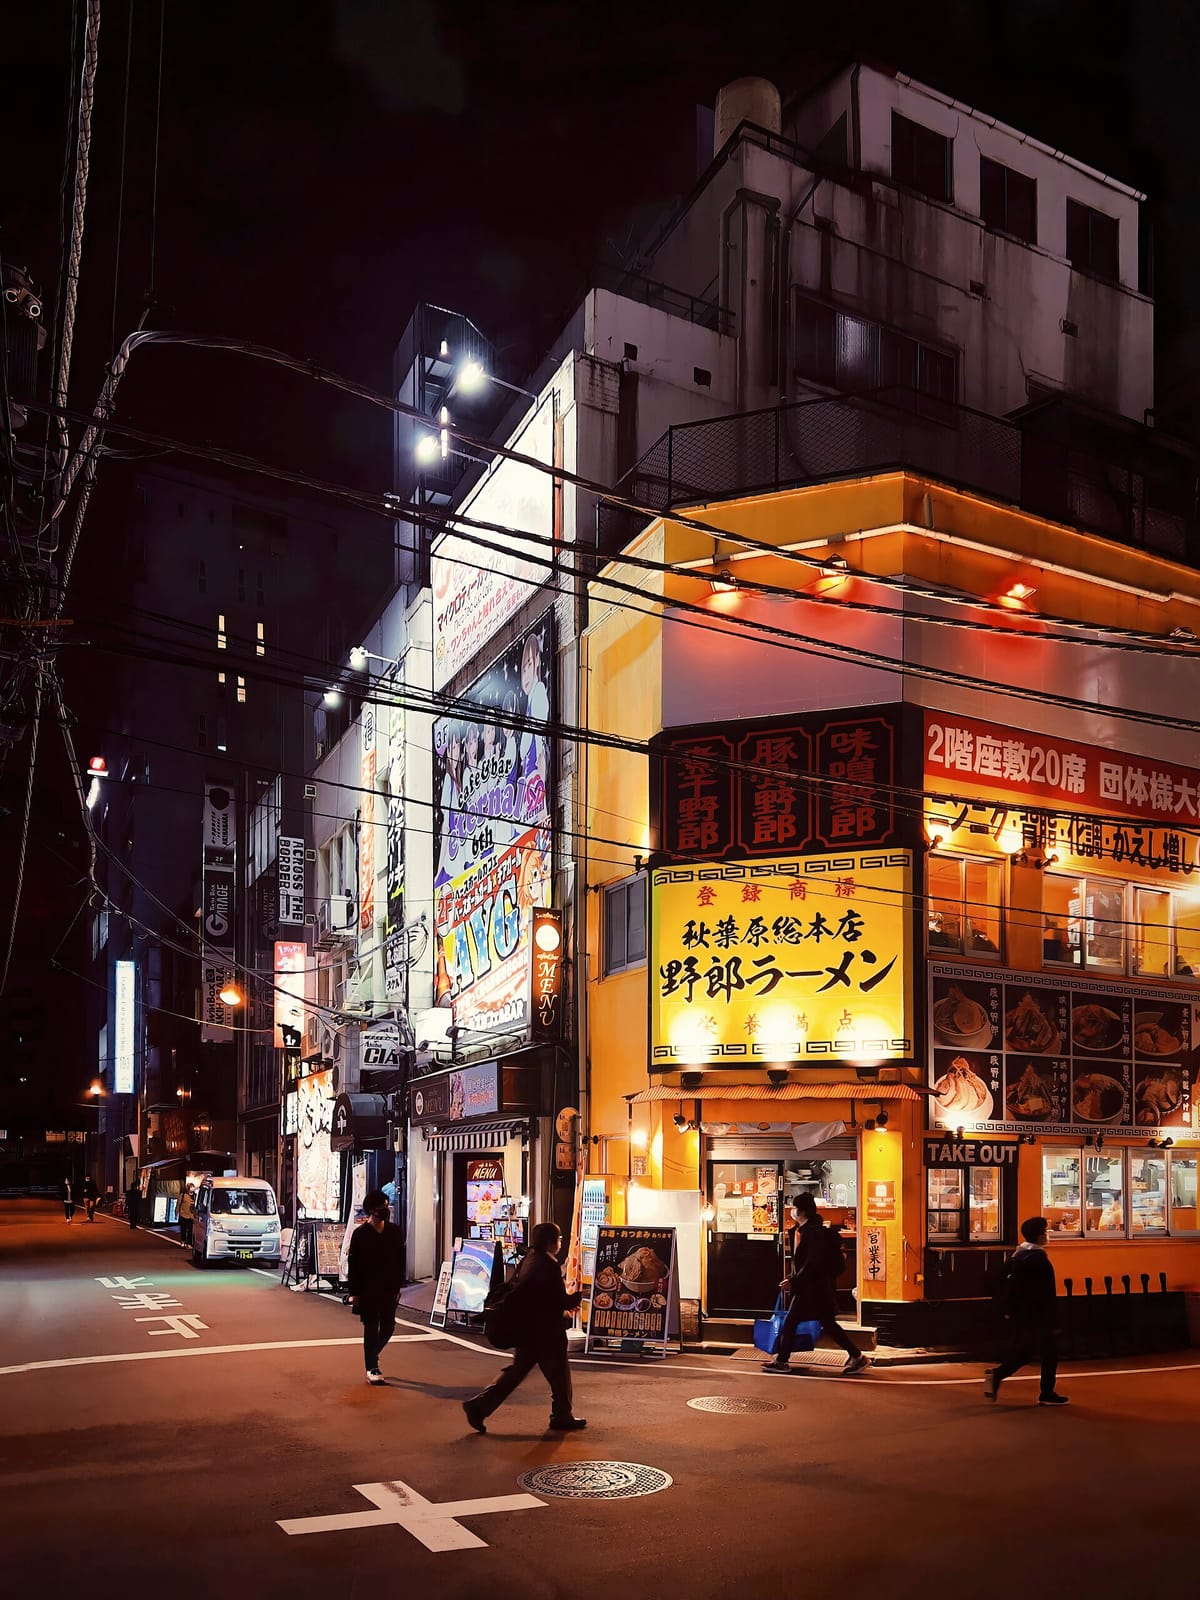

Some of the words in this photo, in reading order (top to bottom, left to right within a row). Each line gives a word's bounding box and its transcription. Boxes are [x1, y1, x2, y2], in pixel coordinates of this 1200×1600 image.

[927, 723, 1087, 795] 2階座敷20席
[1099, 761, 1200, 817] 団体様大
[449, 777, 526, 860] eternal
[471, 824, 494, 857] 6th
[280, 839, 290, 889] BORDER
[292, 841, 303, 890] ACROSS
[205, 884, 229, 937] GARAGE
[292, 896, 303, 920] THE
[437, 891, 453, 924] 2F
[696, 877, 855, 907] 登録商標
[682, 909, 865, 950] 秋葉原総本店
[537, 961, 558, 1027] MENU
[660, 950, 898, 1004] 野郎ラーメン
[364, 1048, 399, 1064] CIA
[472, 1167, 498, 1180] MENU
[928, 1144, 976, 1163] TAKE
[980, 1144, 1017, 1164] OUT
[867, 1228, 881, 1280] 営業中
